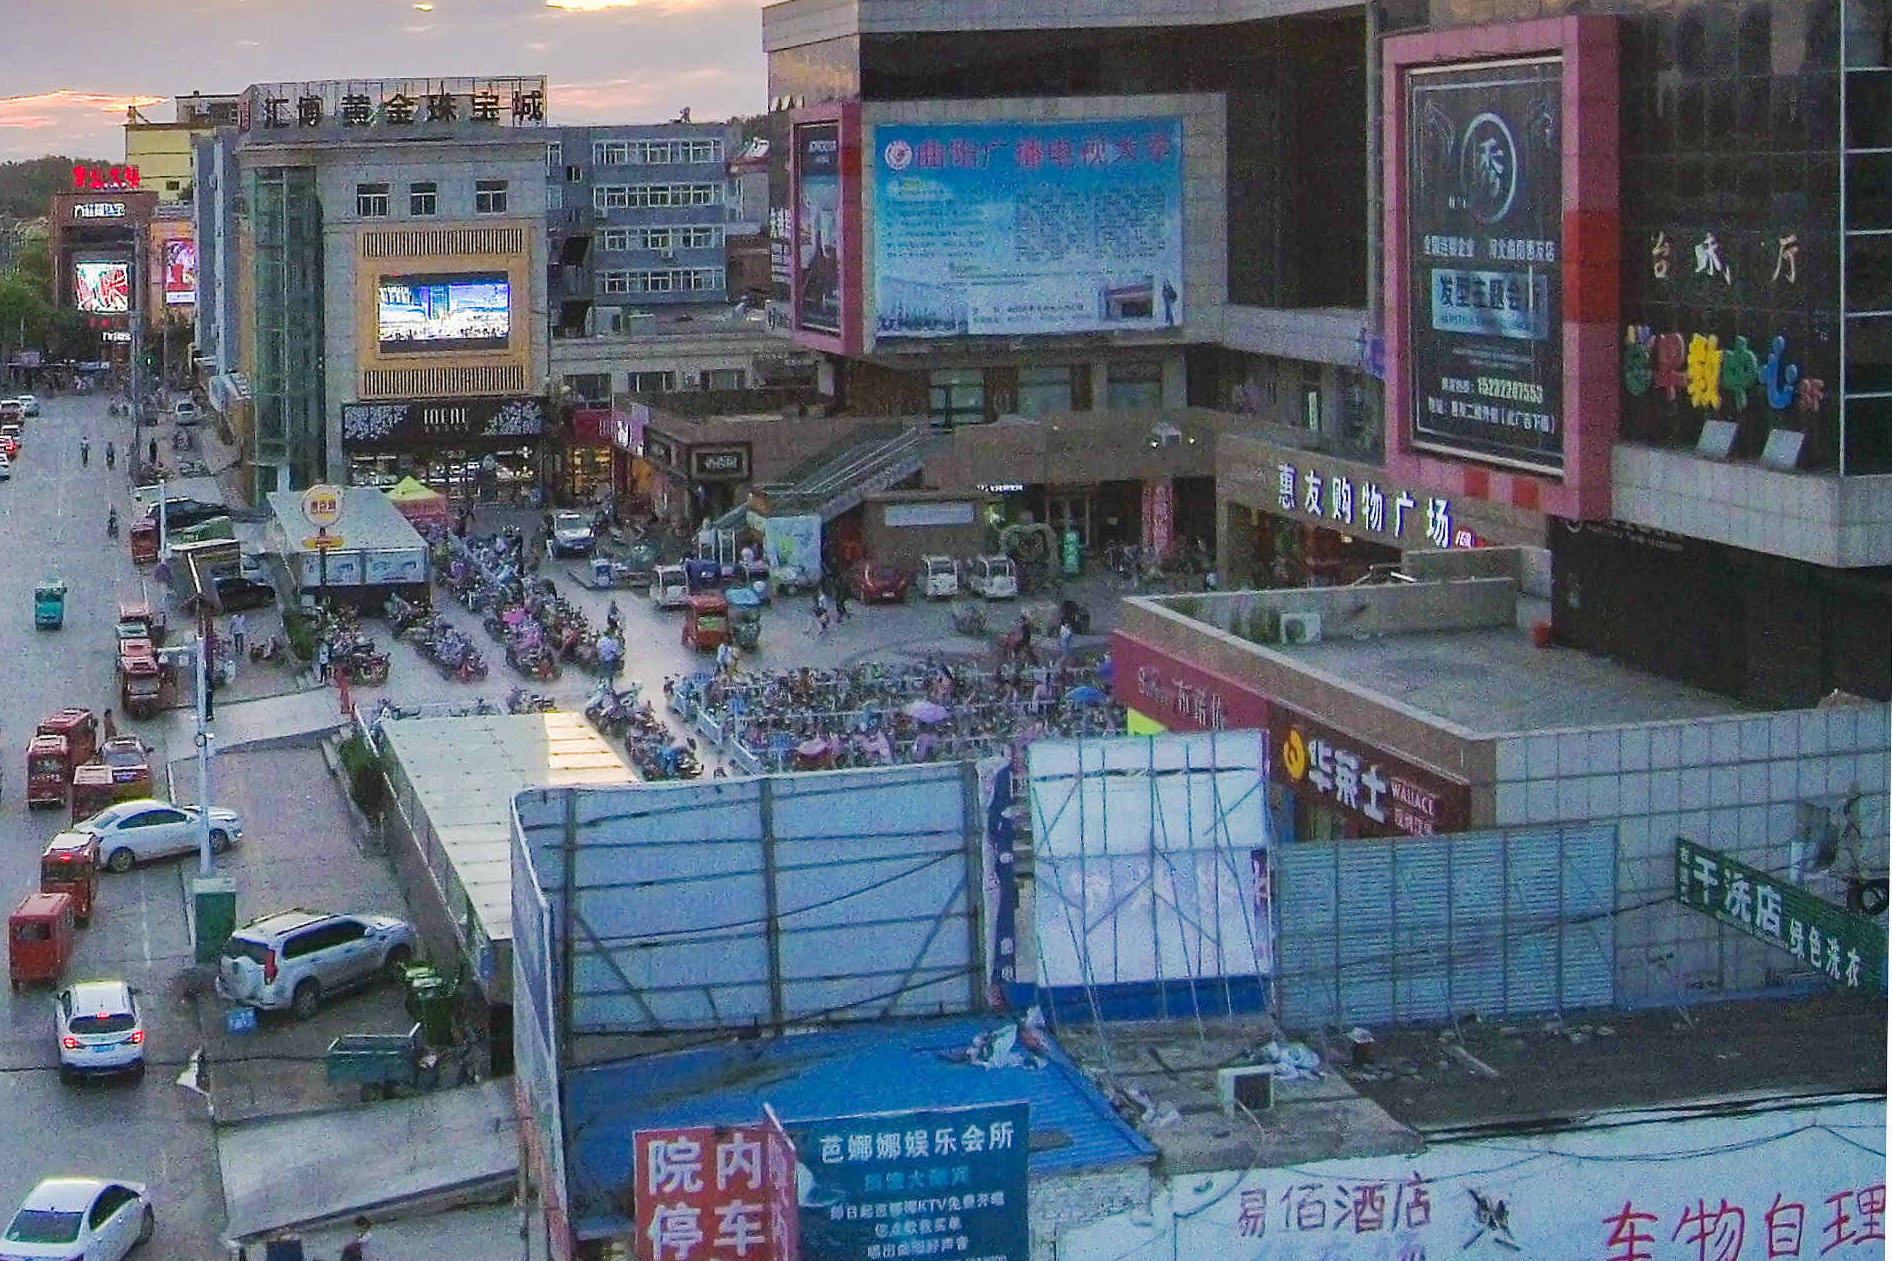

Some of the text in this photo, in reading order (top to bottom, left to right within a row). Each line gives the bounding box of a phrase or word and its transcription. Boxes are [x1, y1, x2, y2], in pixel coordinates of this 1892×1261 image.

[1279, 462, 1452, 548] 惠友购物广场
[1308, 739, 1388, 824] 华莱士
[1693, 853, 1782, 937] 干洗店
[647, 1133, 764, 1196] 院内
[647, 1198, 766, 1261] 停车
[1238, 1173, 1431, 1238] 易佰酒店
[1602, 1184, 1885, 1261] 车物自理
